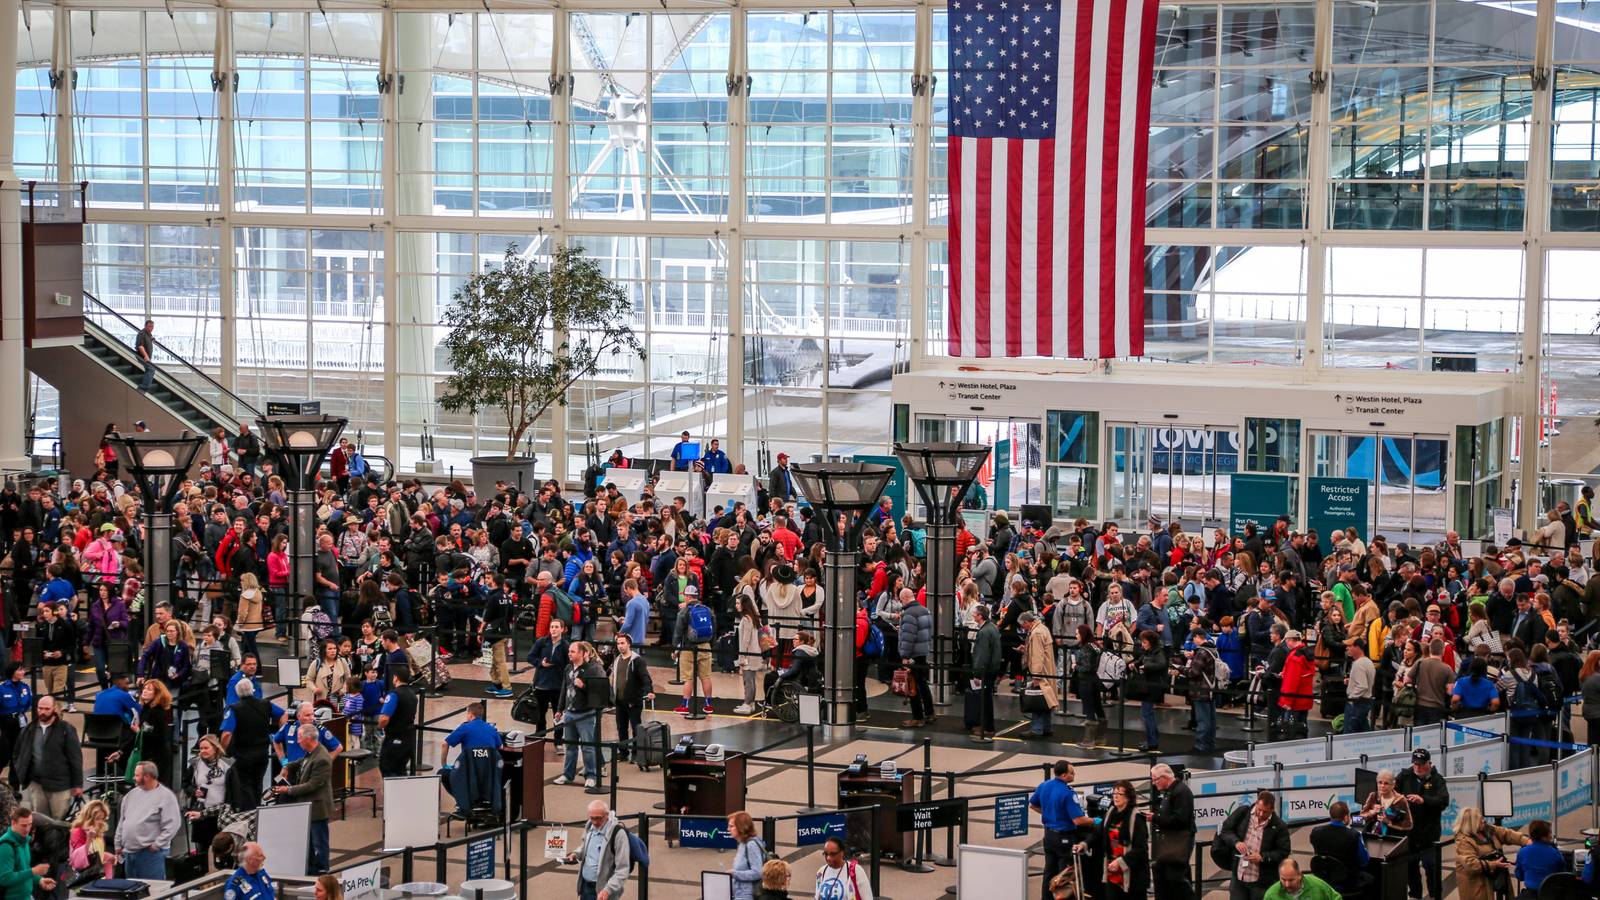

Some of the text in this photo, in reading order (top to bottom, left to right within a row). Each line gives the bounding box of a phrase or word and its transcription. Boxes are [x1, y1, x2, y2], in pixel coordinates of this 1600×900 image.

[1381, 396, 1401, 404] Hotel,
[1320, 485, 1360, 494] Restricted
[1328, 494, 1353, 502] Access
[472, 749, 489, 758] TSA
[1290, 800, 1323, 810] TSA Pre
[914, 811, 931, 820] Wait
[1211, 808, 1224, 817] Pre
[914, 820, 932, 828] Here
[681, 829, 695, 838] TSA
[696, 830, 708, 838] Pre
[798, 828, 810, 837] TSA
[811, 827, 821, 835] Pre
[357, 877, 369, 888] Pre
